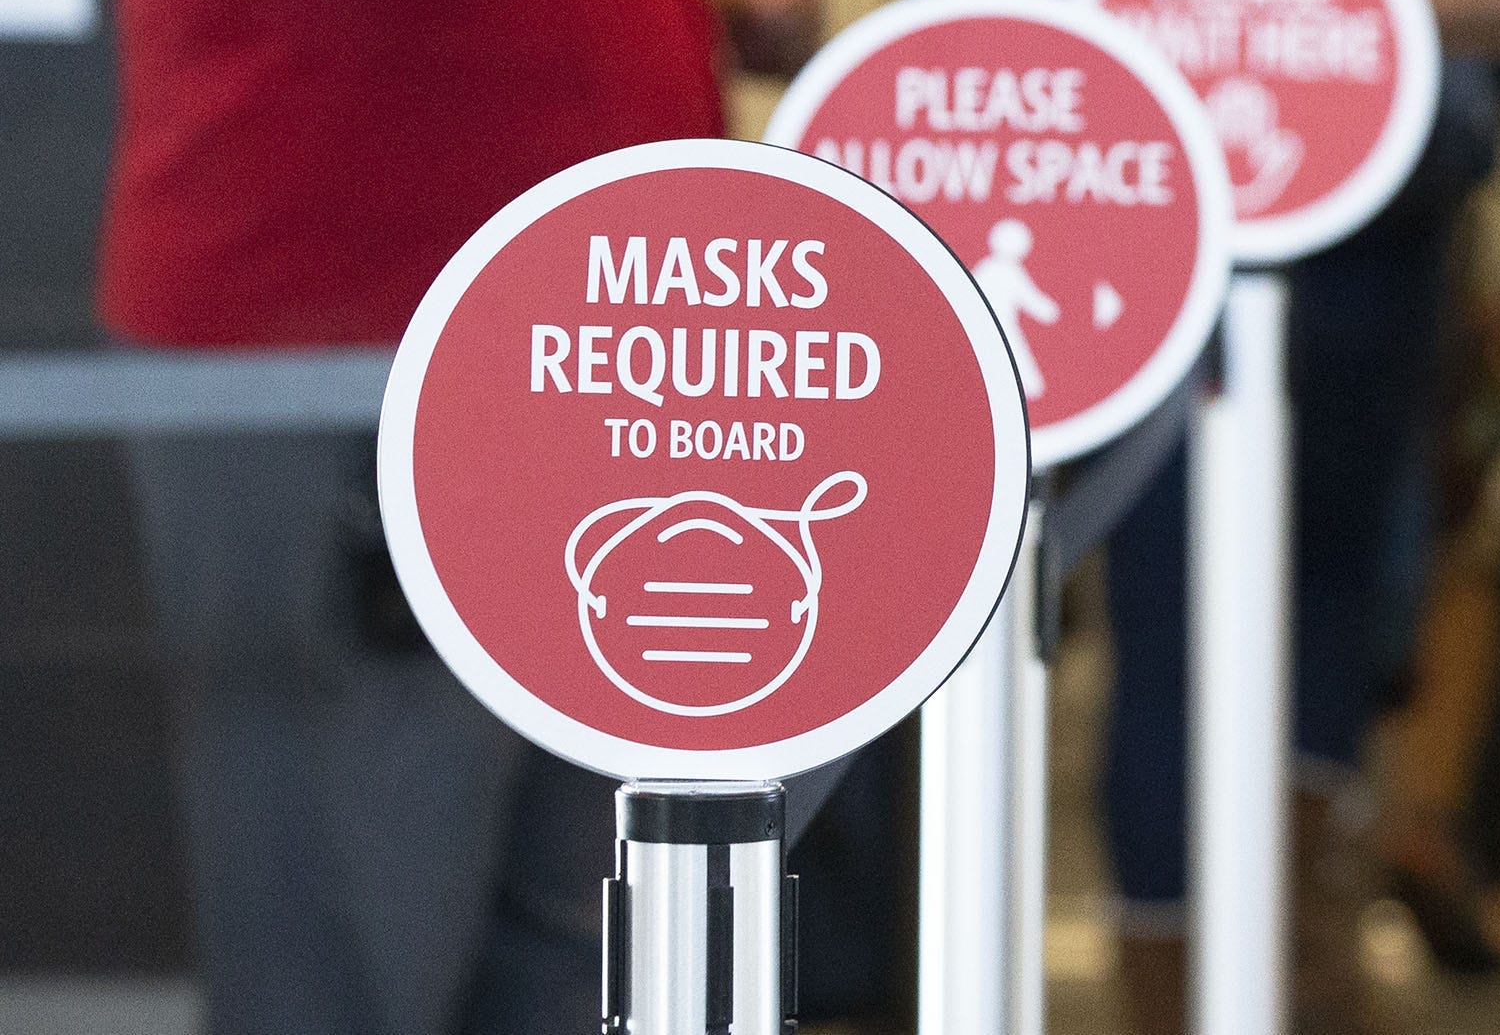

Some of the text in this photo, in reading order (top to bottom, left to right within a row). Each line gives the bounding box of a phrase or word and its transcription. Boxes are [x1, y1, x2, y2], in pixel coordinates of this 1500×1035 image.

[1247, 10, 1380, 81] HERE
[895, 67, 1084, 132] PLEASE
[1006, 140, 1173, 205] SPACE
[586, 235, 828, 309] MASKS
[530, 324, 881, 407] REQUIRED
[604, 418, 805, 461] TO BOARD
